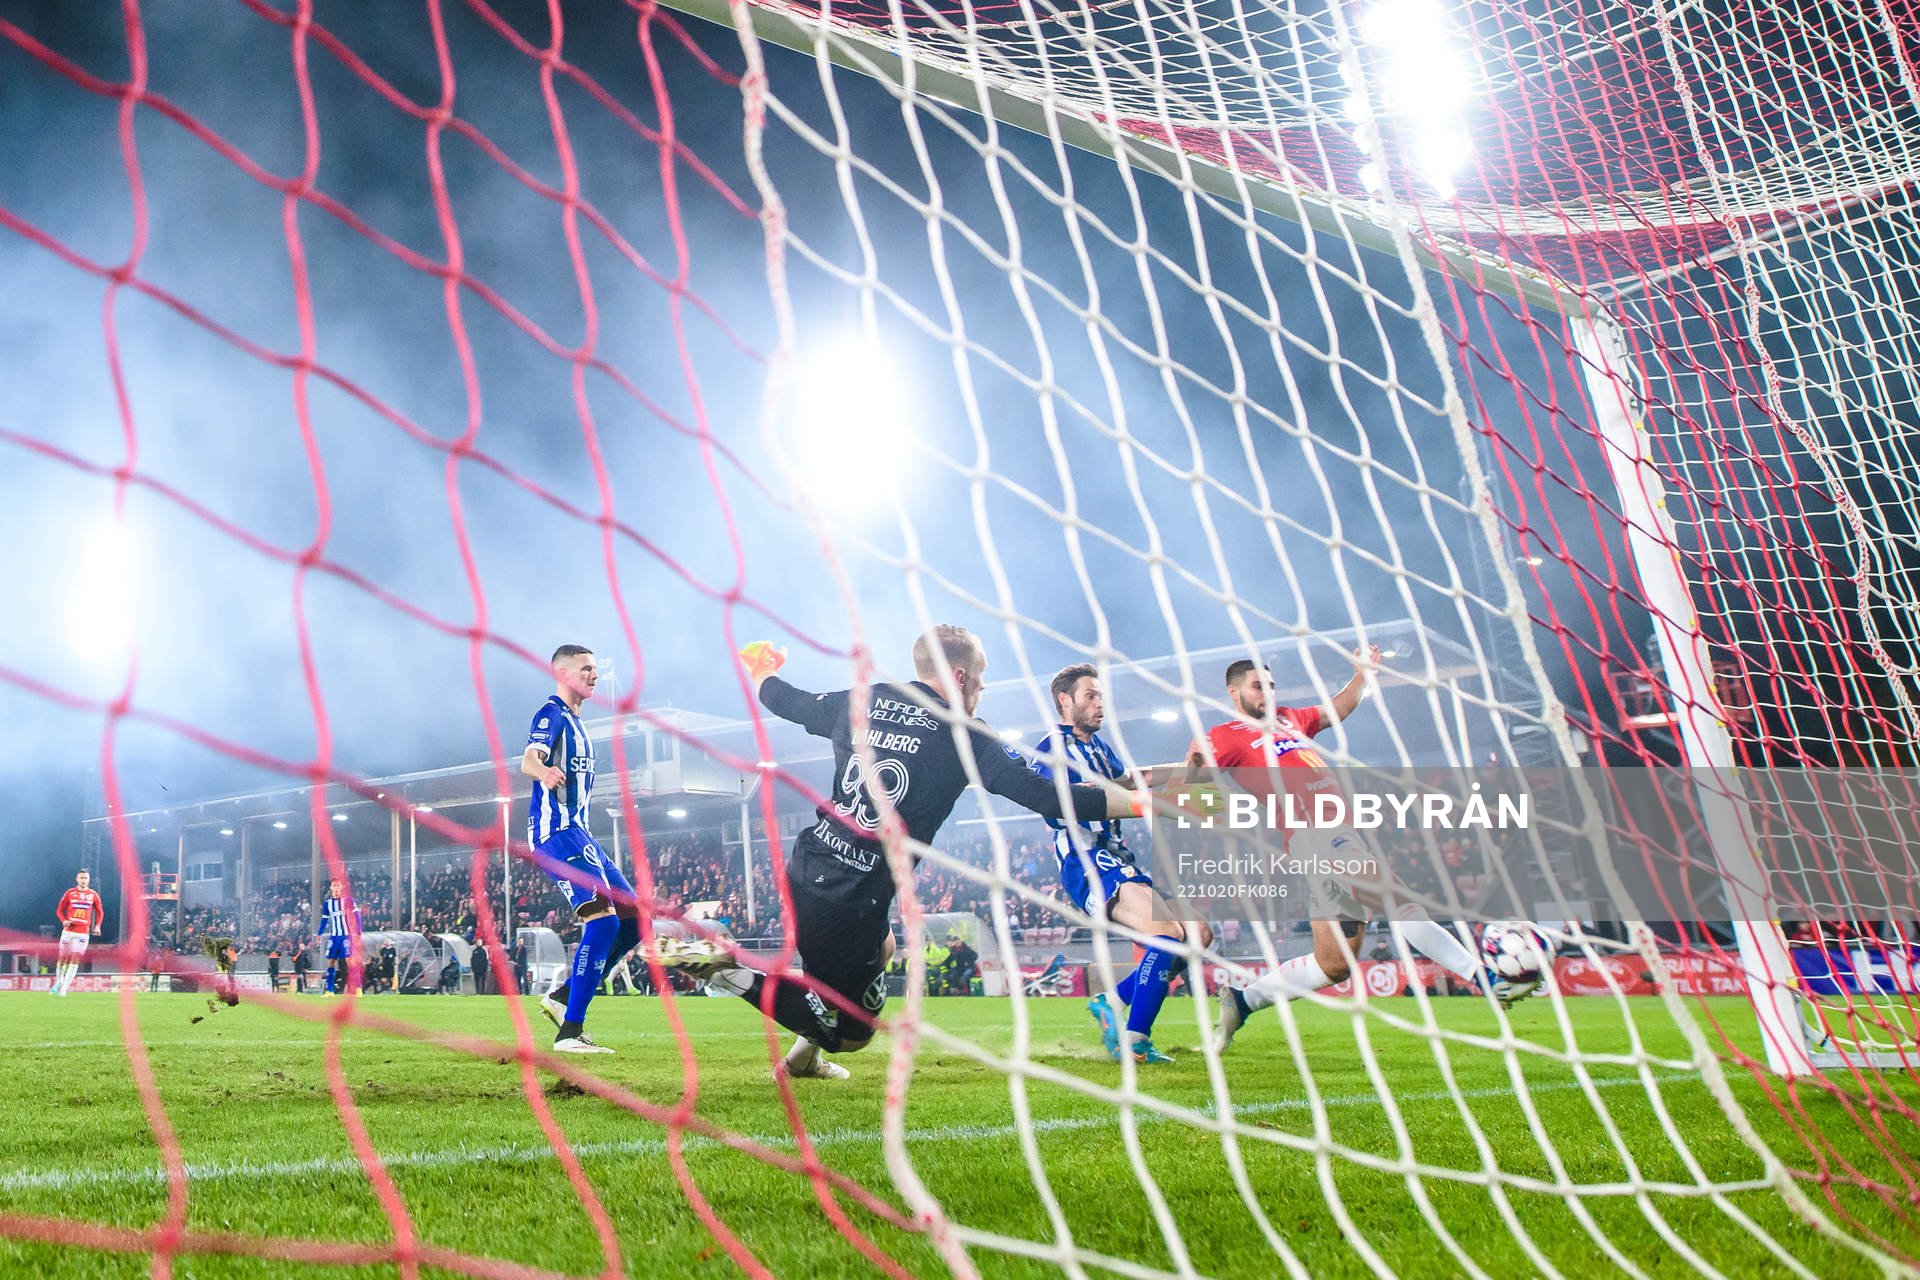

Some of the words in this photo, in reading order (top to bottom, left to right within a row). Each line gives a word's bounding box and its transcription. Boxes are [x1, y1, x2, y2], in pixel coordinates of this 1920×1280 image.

[874, 697, 929, 717] NORDIC
[851, 729, 921, 754] HLBERG
[834, 753, 910, 831] 99
